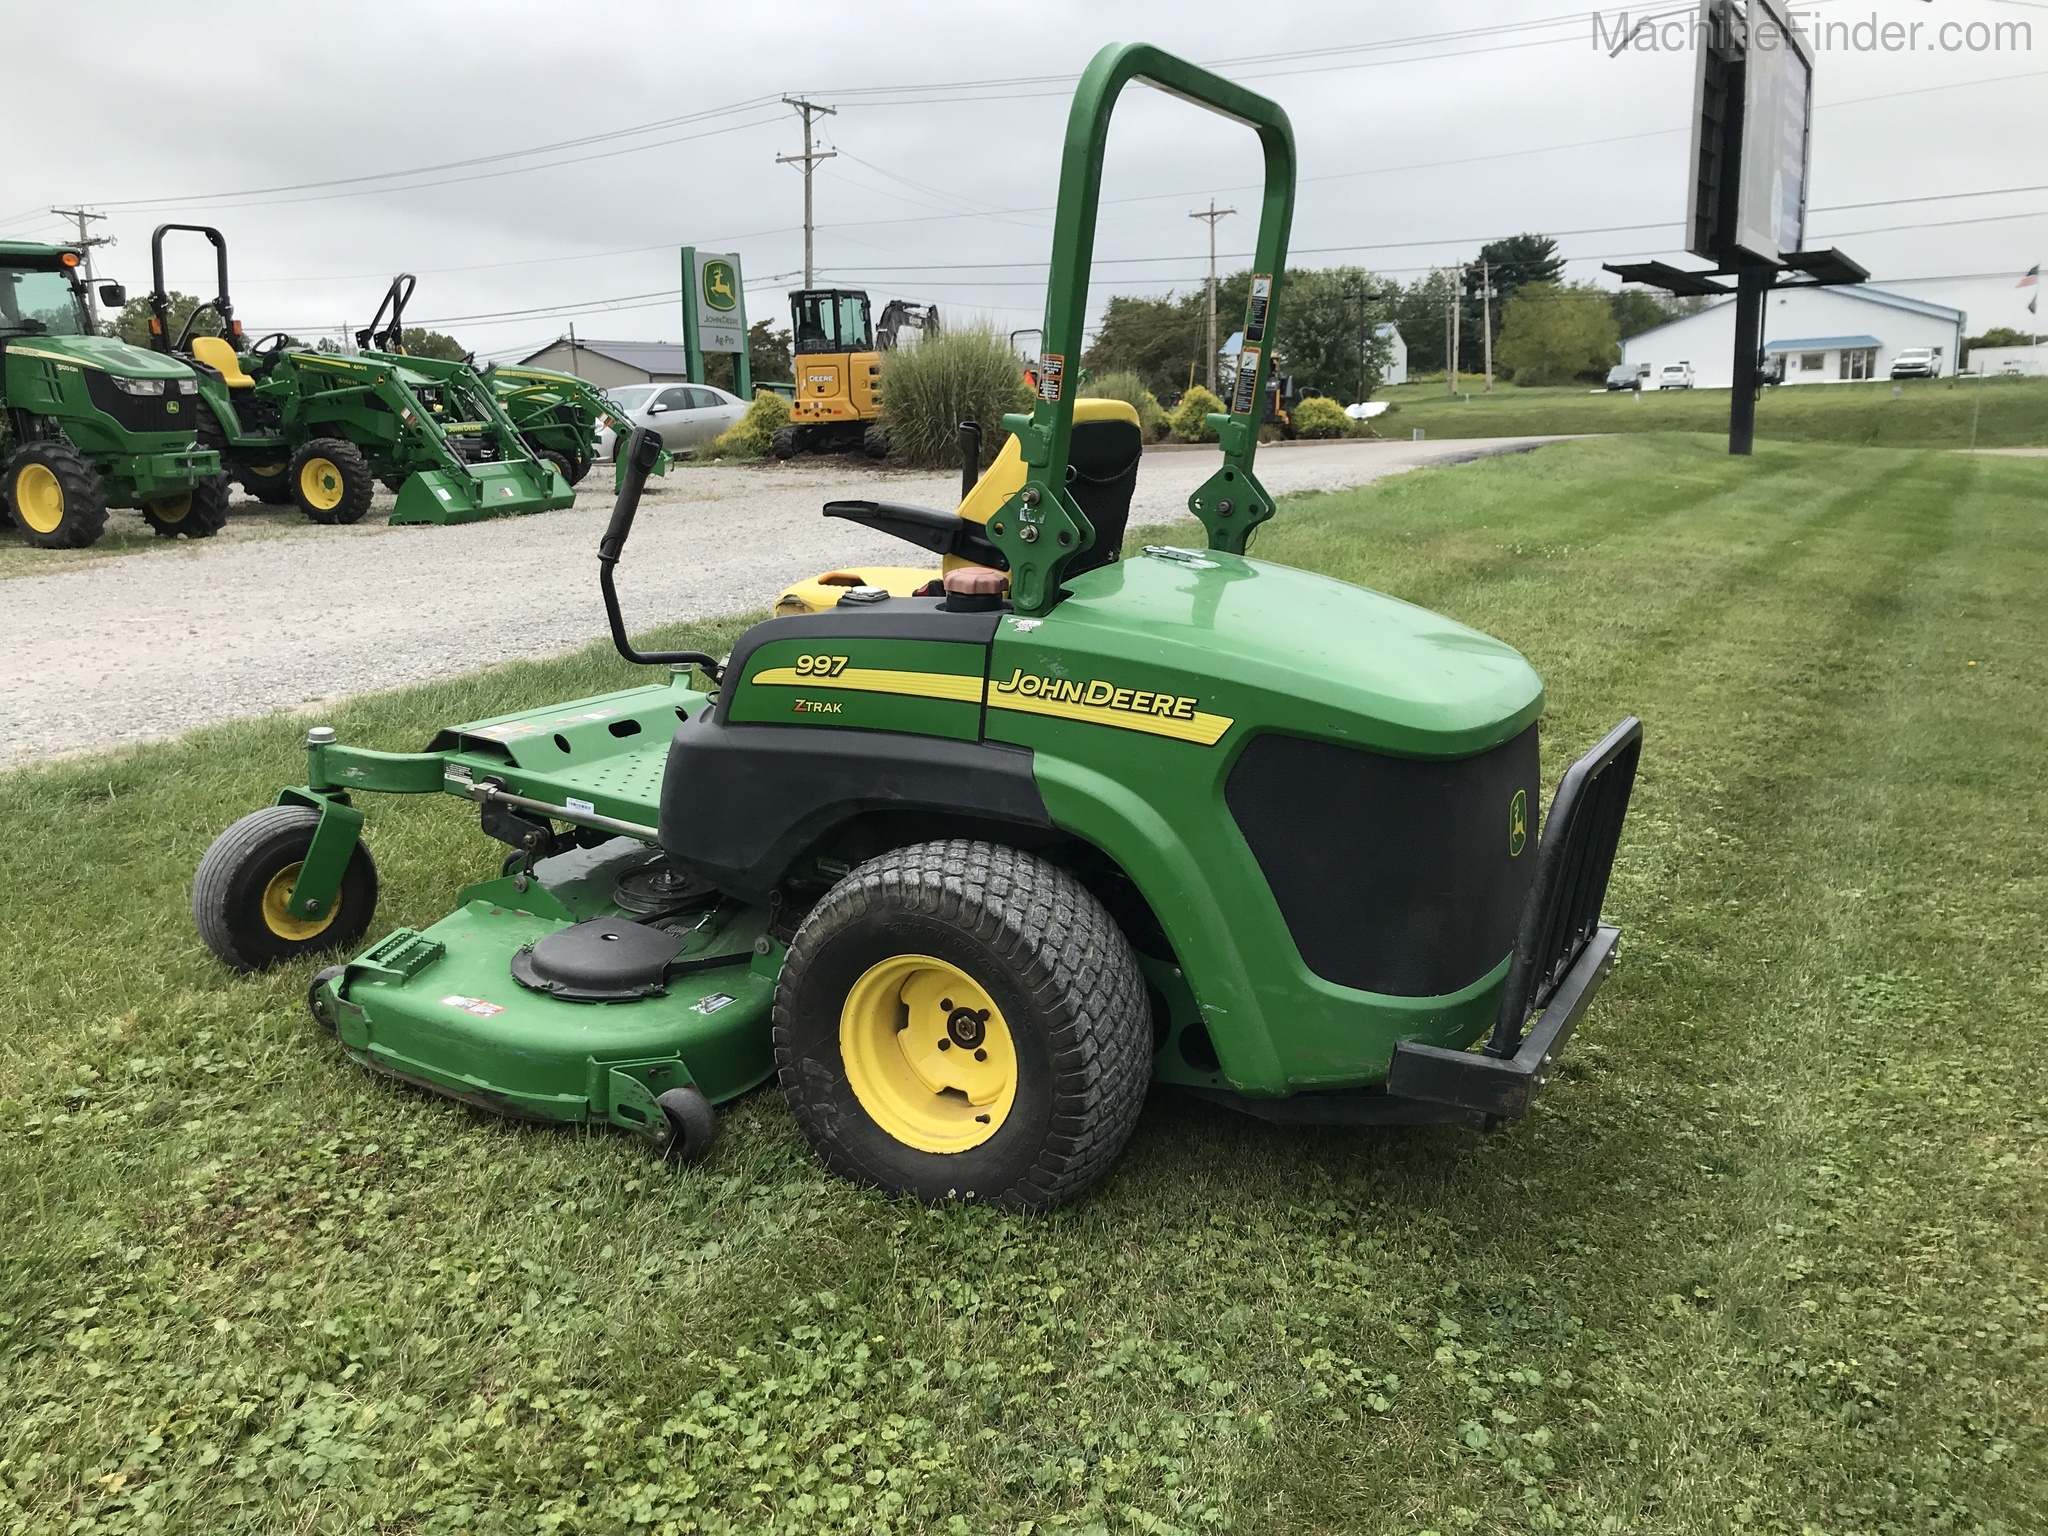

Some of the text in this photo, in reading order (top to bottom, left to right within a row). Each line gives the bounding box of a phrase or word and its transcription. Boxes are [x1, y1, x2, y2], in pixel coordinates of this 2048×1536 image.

[704, 315, 739, 325] JOHN DEERE
[715, 334, 735, 346] Ag-Pro
[795, 654, 849, 677] 997
[998, 668, 1197, 720] JOHN DEERE
[793, 698, 843, 713] ZTRAK
[884, 921, 947, 940] MULTI
